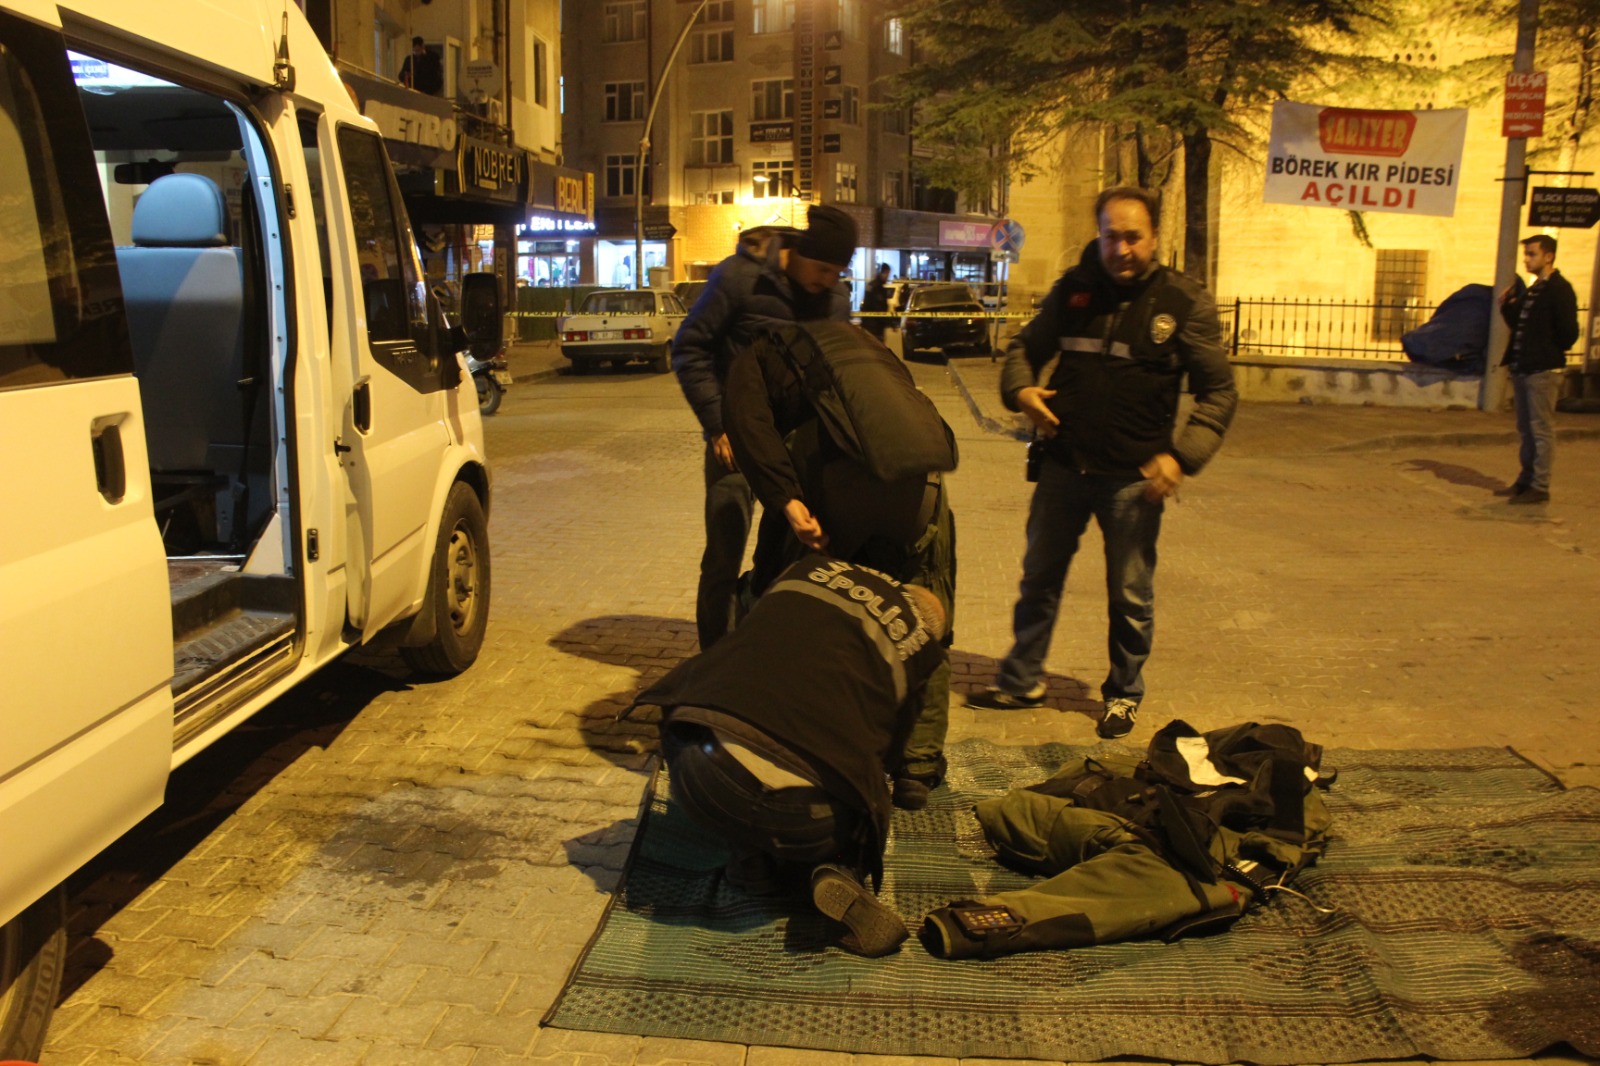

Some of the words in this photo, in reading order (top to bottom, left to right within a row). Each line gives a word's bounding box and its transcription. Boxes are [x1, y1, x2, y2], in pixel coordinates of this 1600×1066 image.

[1325, 115, 1408, 149] SARIYER
[474, 146, 521, 188] NOBREN
[1271, 155, 1339, 178] BÖREK
[1345, 163, 1380, 181] KIR
[1386, 161, 1454, 186] PİDESİ
[1301, 181, 1417, 209] AÇILDI
